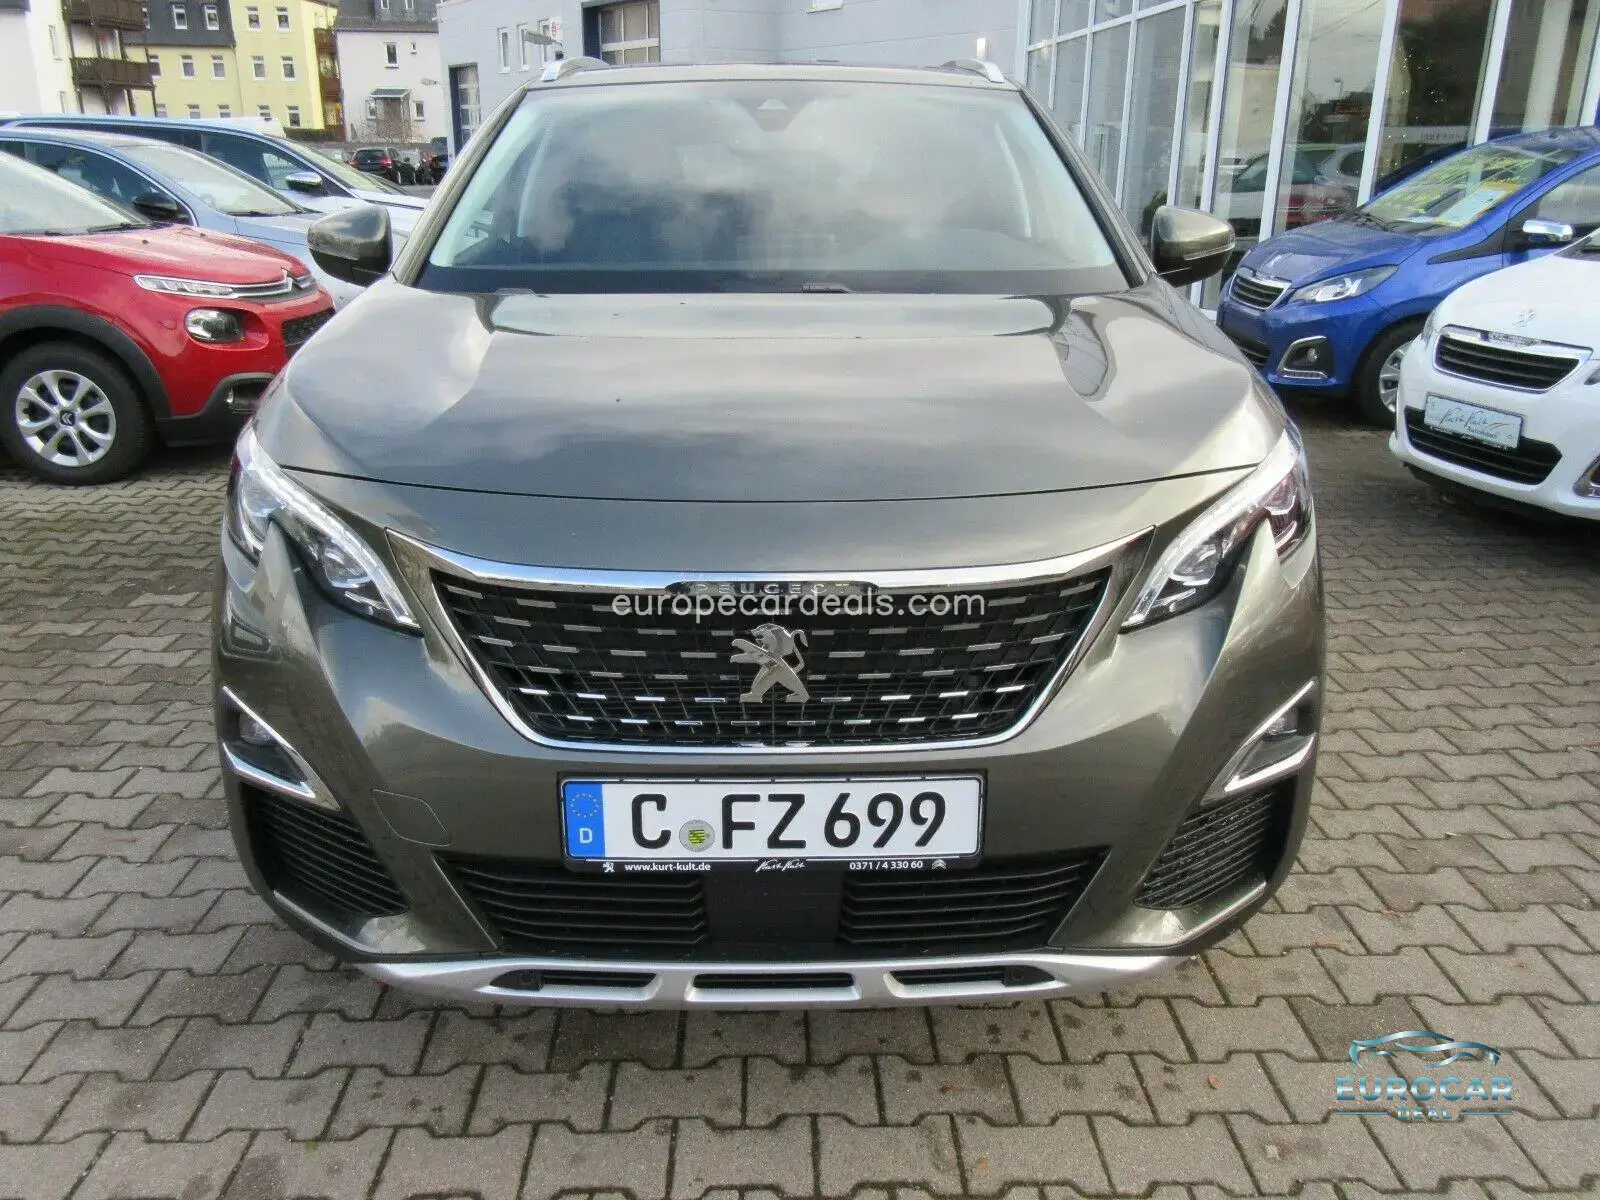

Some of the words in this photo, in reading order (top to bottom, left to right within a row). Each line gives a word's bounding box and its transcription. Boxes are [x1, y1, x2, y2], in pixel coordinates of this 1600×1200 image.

[631, 793, 671, 849] C
[722, 794, 806, 849] FZ
[824, 792, 946, 848] 699
[579, 828, 593, 844] D
[625, 862, 711, 872] www.kurt-kult.de
[849, 861, 873, 870] 0371
[882, 861, 888, 870] 4
[890, 861, 909, 870] 330
[910, 860, 923, 869] 60
